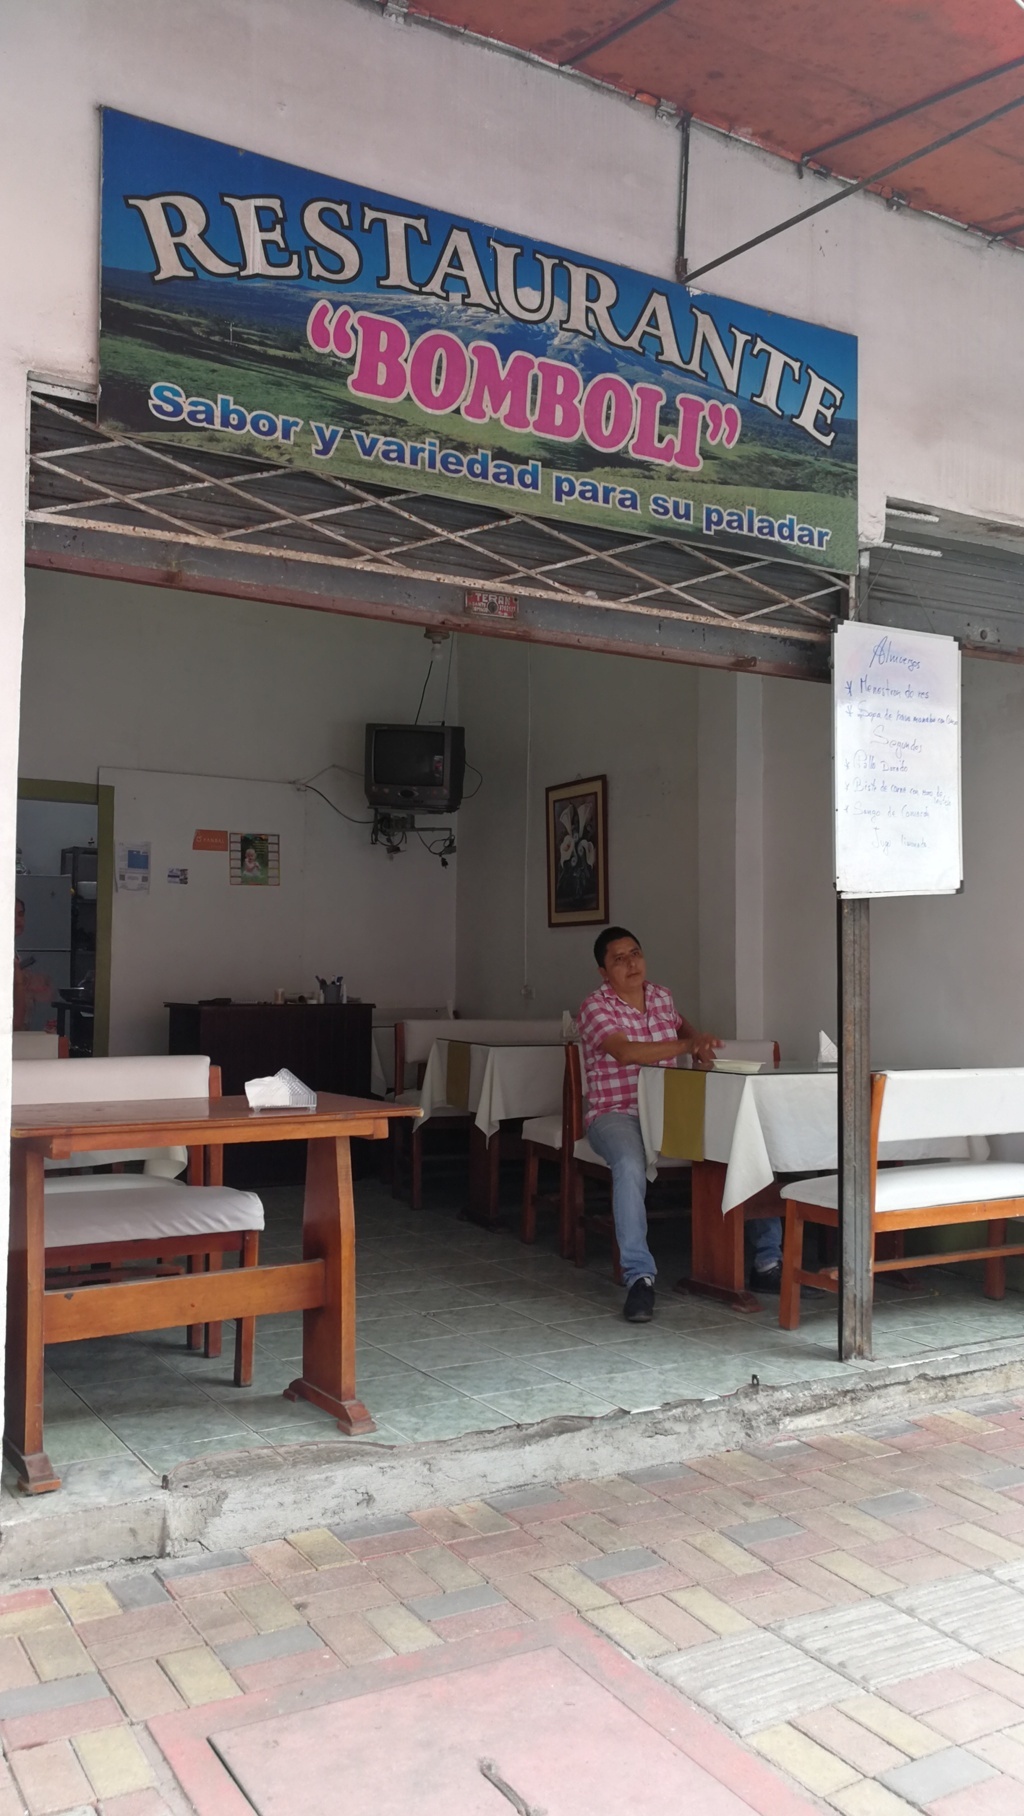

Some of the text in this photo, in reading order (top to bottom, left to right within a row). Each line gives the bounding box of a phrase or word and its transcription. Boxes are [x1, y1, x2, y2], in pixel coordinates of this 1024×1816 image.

[123, 192, 844, 447] RESTAURANTE
[148, 381, 832, 551] Sabor y variedad para su paladar
